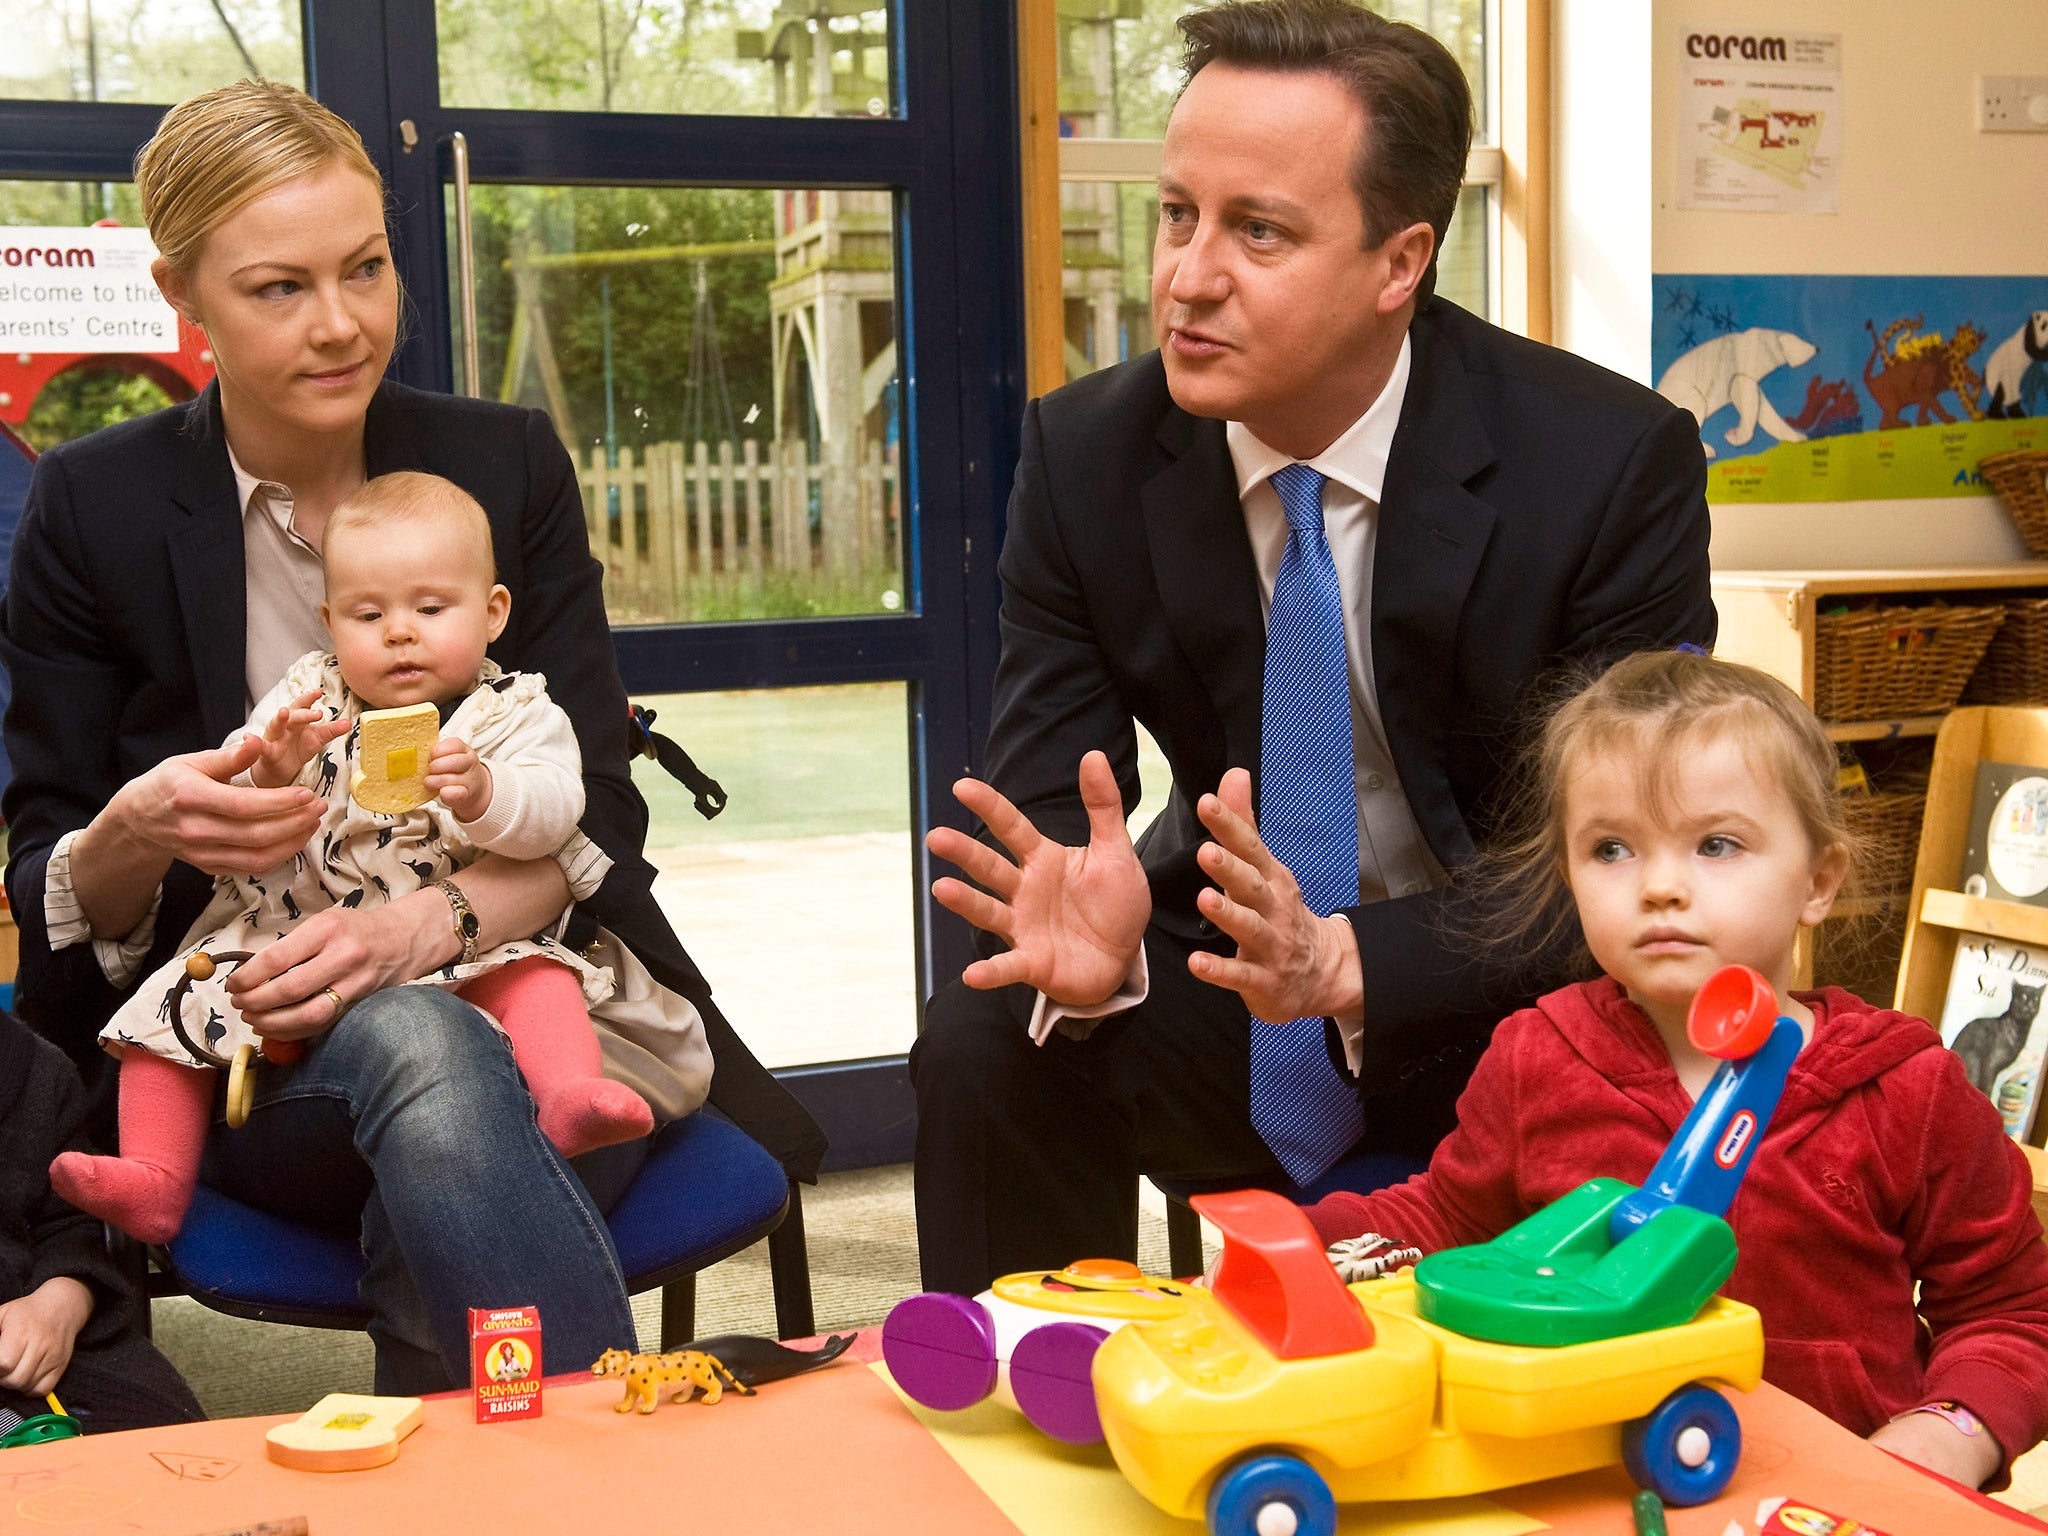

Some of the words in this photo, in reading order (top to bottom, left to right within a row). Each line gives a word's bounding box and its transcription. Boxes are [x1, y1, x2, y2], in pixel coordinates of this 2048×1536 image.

[1686, 33, 1787, 62] coram
[0, 247, 95, 267] oram
[93, 284, 116, 302] to
[125, 283, 161, 302] the
[86, 316, 163, 337] Centre
[1972, 973, 1998, 998] Sid
[478, 1380, 540, 1399] SUN-MAID
[490, 1399, 530, 1414] RAISINS
